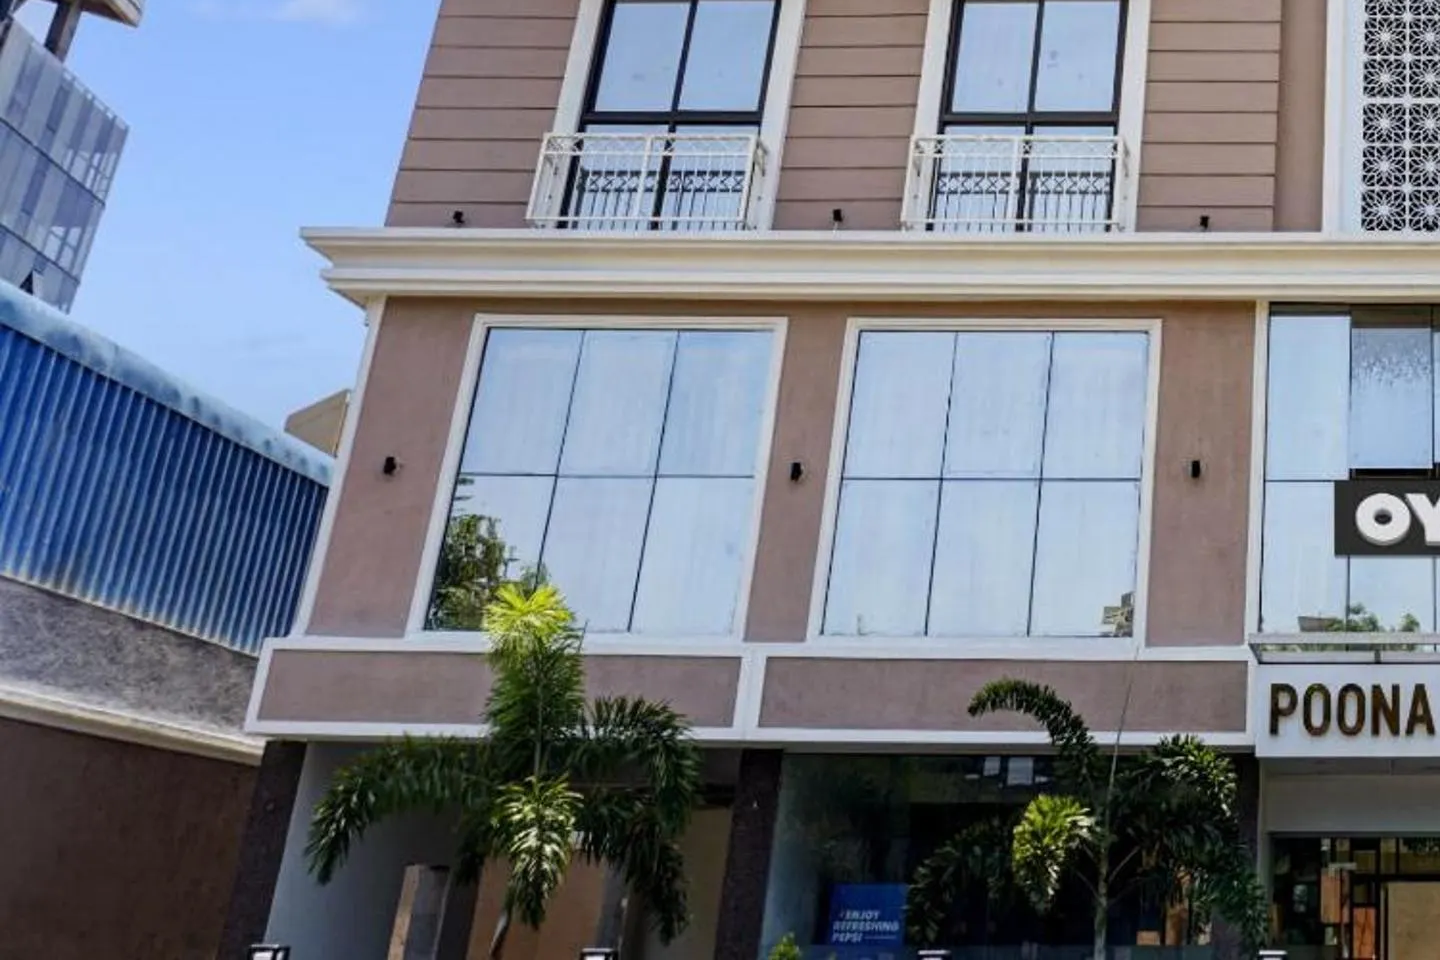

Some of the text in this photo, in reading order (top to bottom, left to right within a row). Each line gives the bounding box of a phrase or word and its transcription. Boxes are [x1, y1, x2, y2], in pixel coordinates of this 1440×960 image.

[1269, 682, 1436, 737] POONA
[844, 909, 880, 920] ENJOY
[832, 920, 900, 932] REFRESHING
[831, 932, 863, 942] PEPSI
